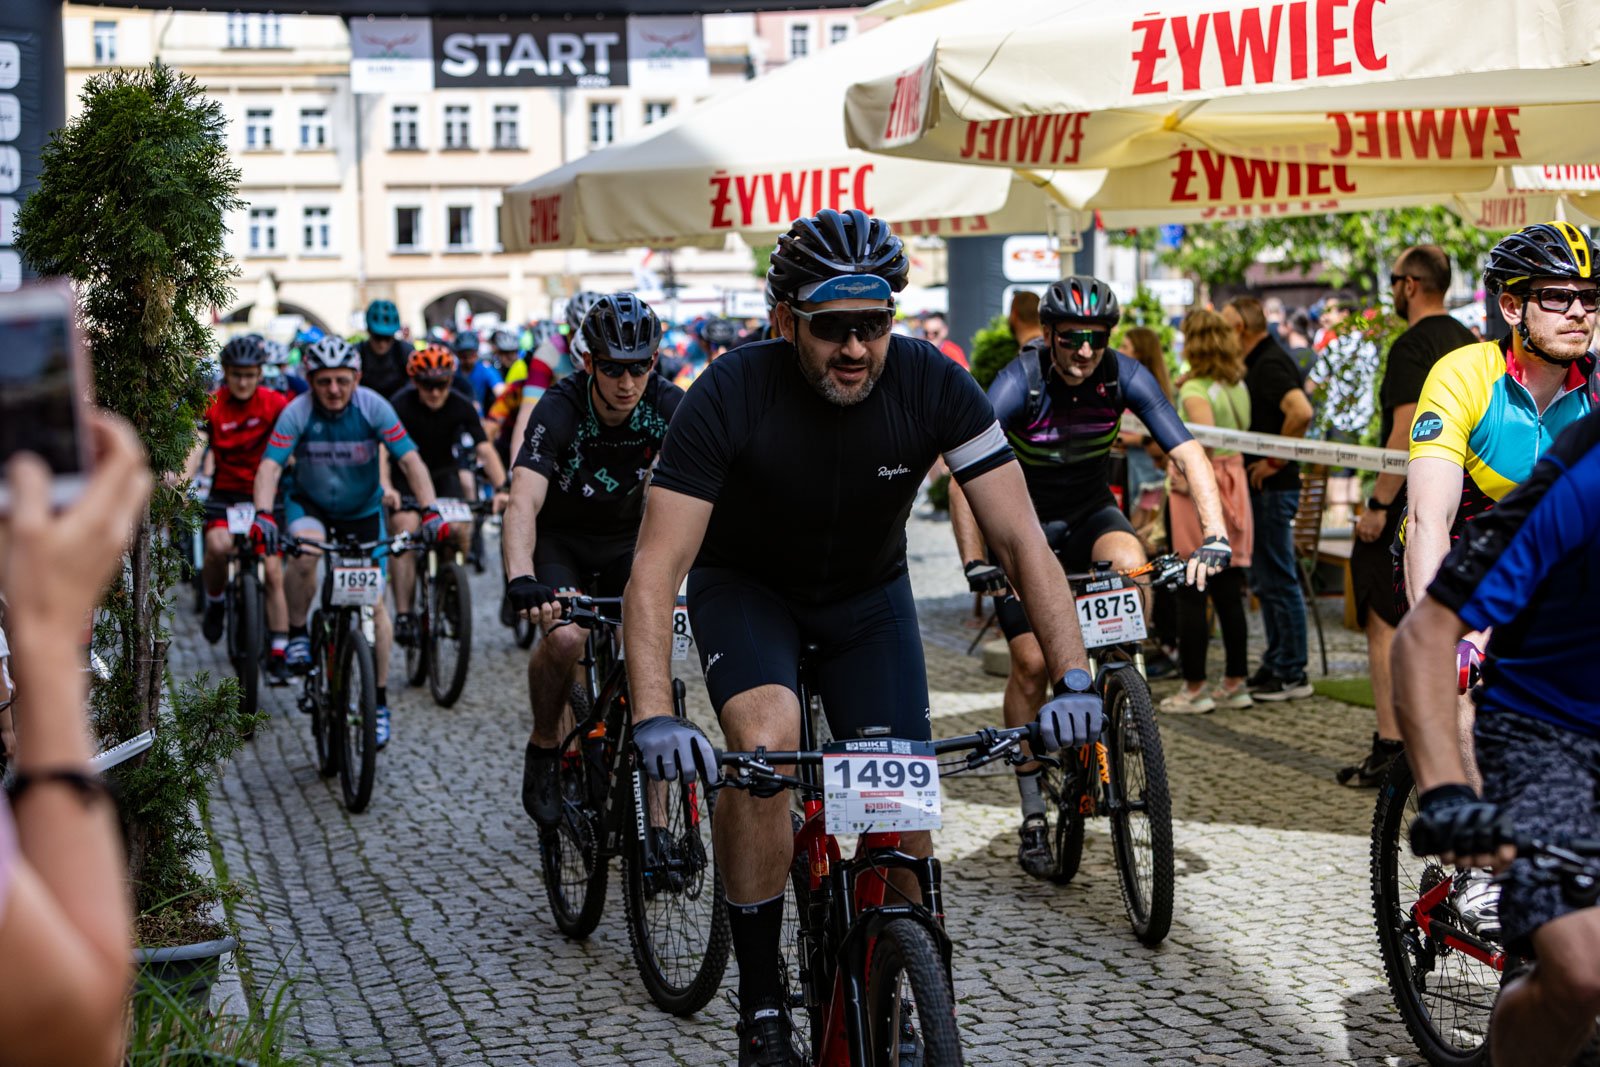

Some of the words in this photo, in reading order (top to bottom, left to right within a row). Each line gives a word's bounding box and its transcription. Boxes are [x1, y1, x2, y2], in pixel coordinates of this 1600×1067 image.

[442, 32, 620, 78] START
[1131, 0, 1388, 95] ŻYWIEC
[709, 164, 875, 230] ŻYWIEC
[338, 571, 377, 588] 1692
[1081, 593, 1137, 621] 1875
[833, 759, 931, 789] 1499
[632, 771, 646, 841] manitou
[1374, 797, 1391, 896] SCHWALBE
